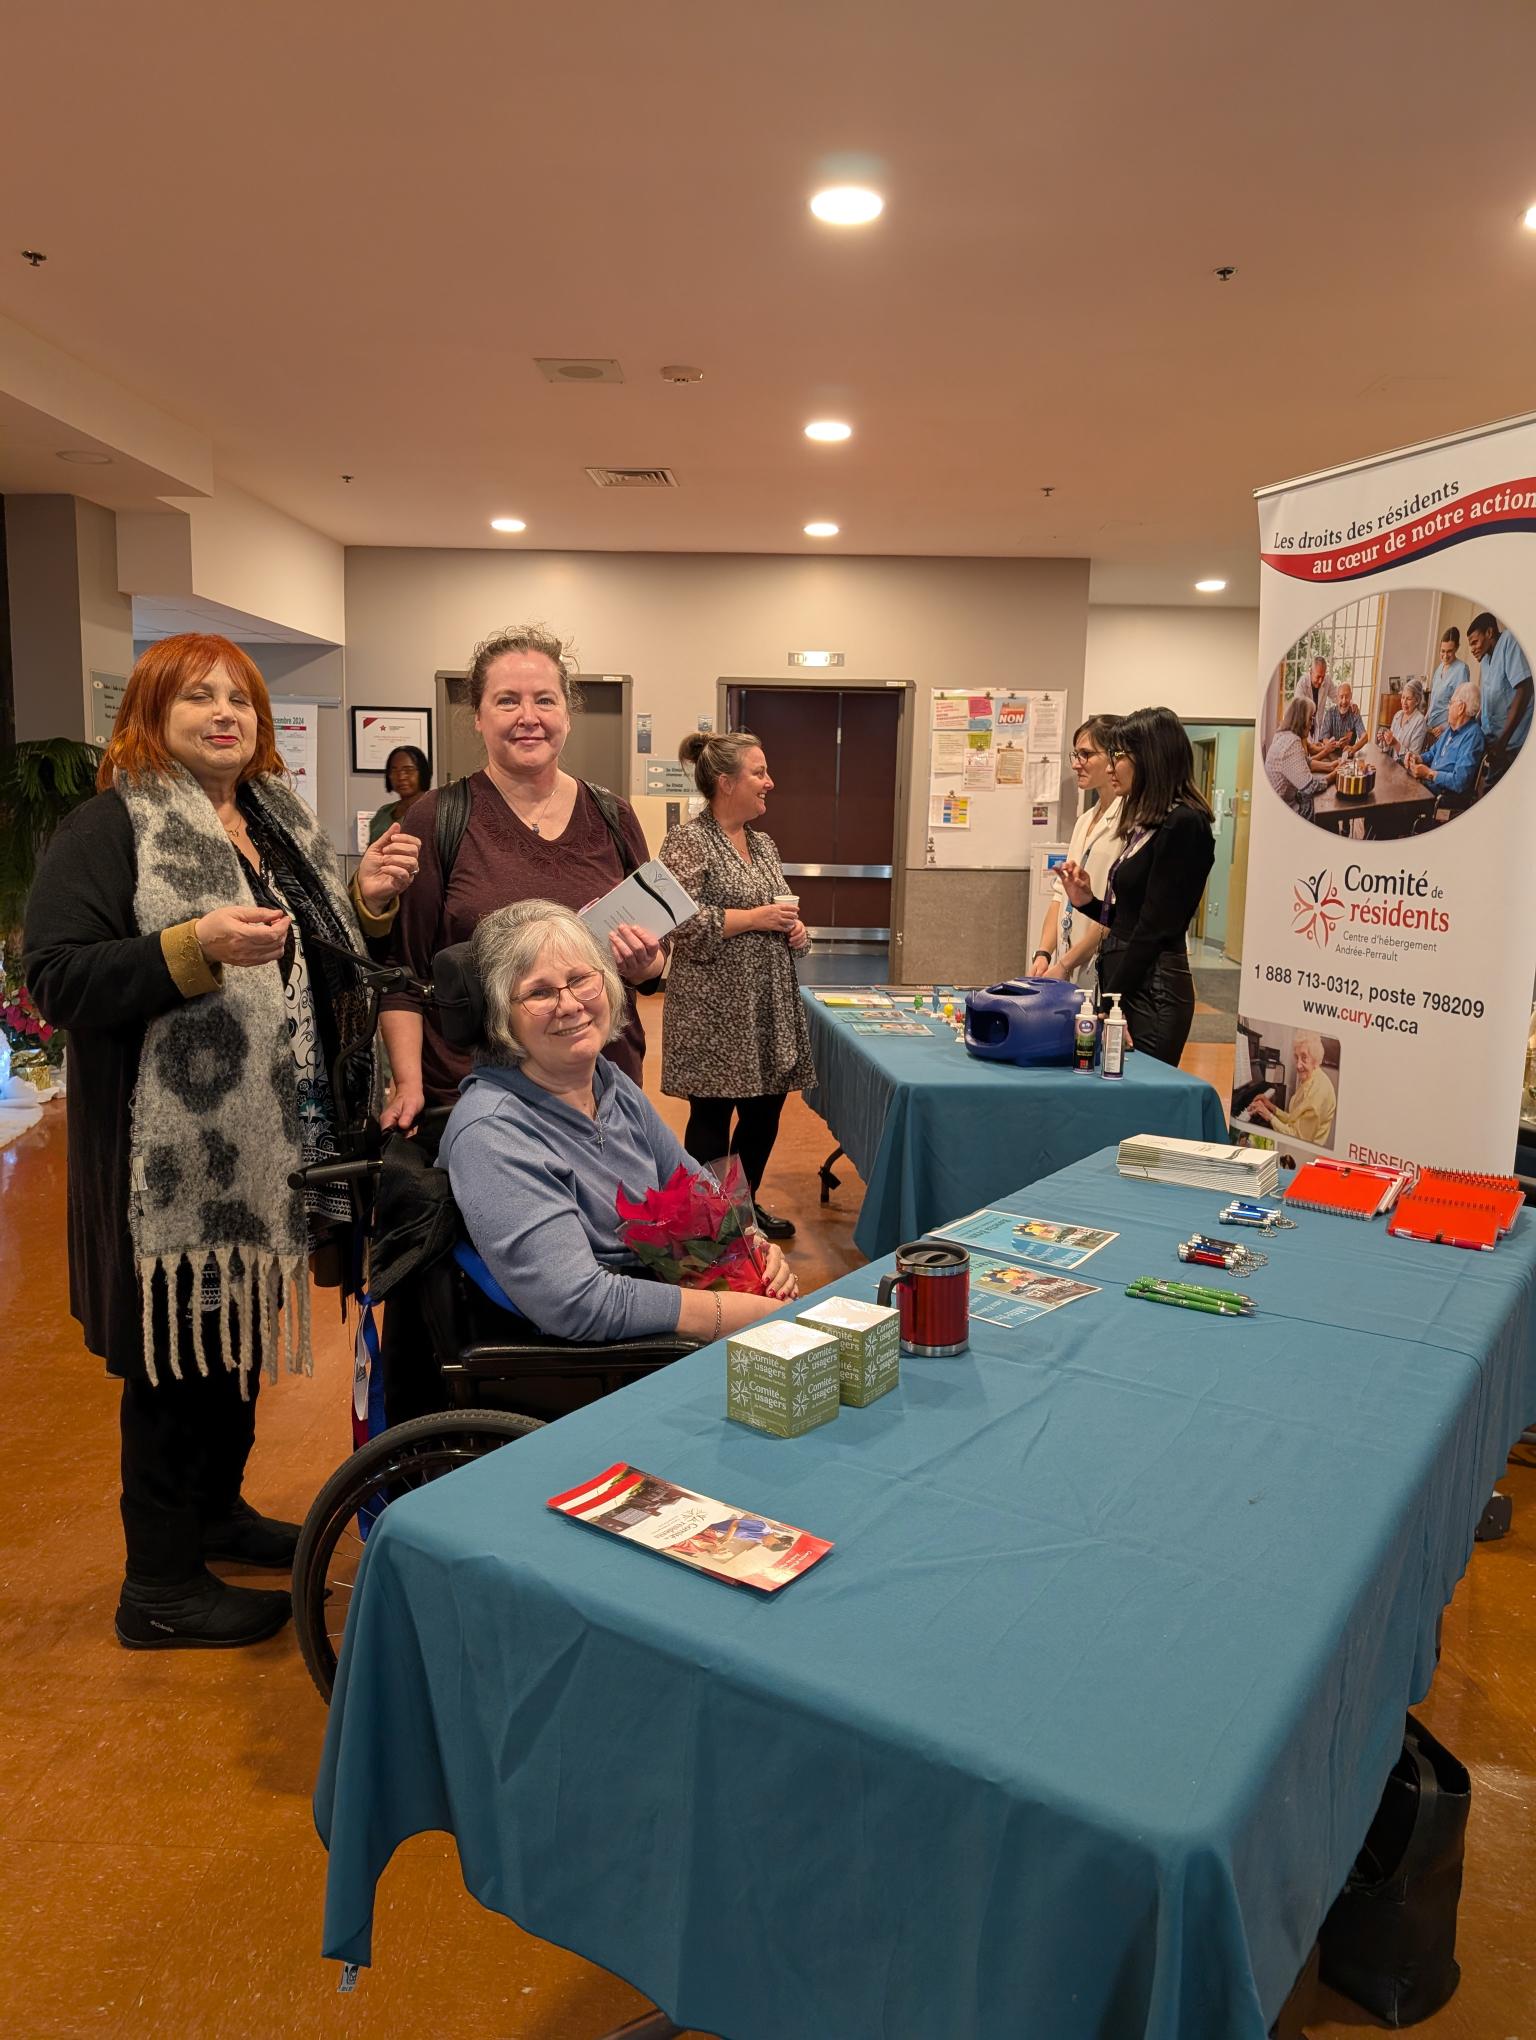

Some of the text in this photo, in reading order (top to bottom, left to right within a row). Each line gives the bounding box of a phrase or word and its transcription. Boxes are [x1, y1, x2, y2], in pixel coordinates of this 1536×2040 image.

[1274, 480, 1460, 549] Les droits des résidents
[1312, 558, 1332, 575] au
[1336, 542, 1381, 571] cœur
[1384, 530, 1407, 554] de
[1411, 507, 1464, 543] notre
[998, 713, 1024, 723] NON
[1344, 864, 1444, 899] Comité de
[1349, 898, 1450, 933] résidents
[1343, 931, 1438, 953] Centre d'hébergement
[1335, 943, 1399, 962] Andrée-Perrault
[1254, 964, 1485, 1019] 1 888 713-0312, poste 798209
[1303, 999, 1419, 1035] www.cury.qc.ca
[749, 1350, 780, 1367] Comité
[807, 1344, 832, 1362] Comité
[812, 1353, 838, 1370] usagers
[754, 1363, 786, 1379] usagers
[749, 1380, 780, 1399] Comité
[807, 1375, 833, 1394] Comité
[812, 1384, 838, 1401] usagers
[754, 1393, 787, 1410] usagers
